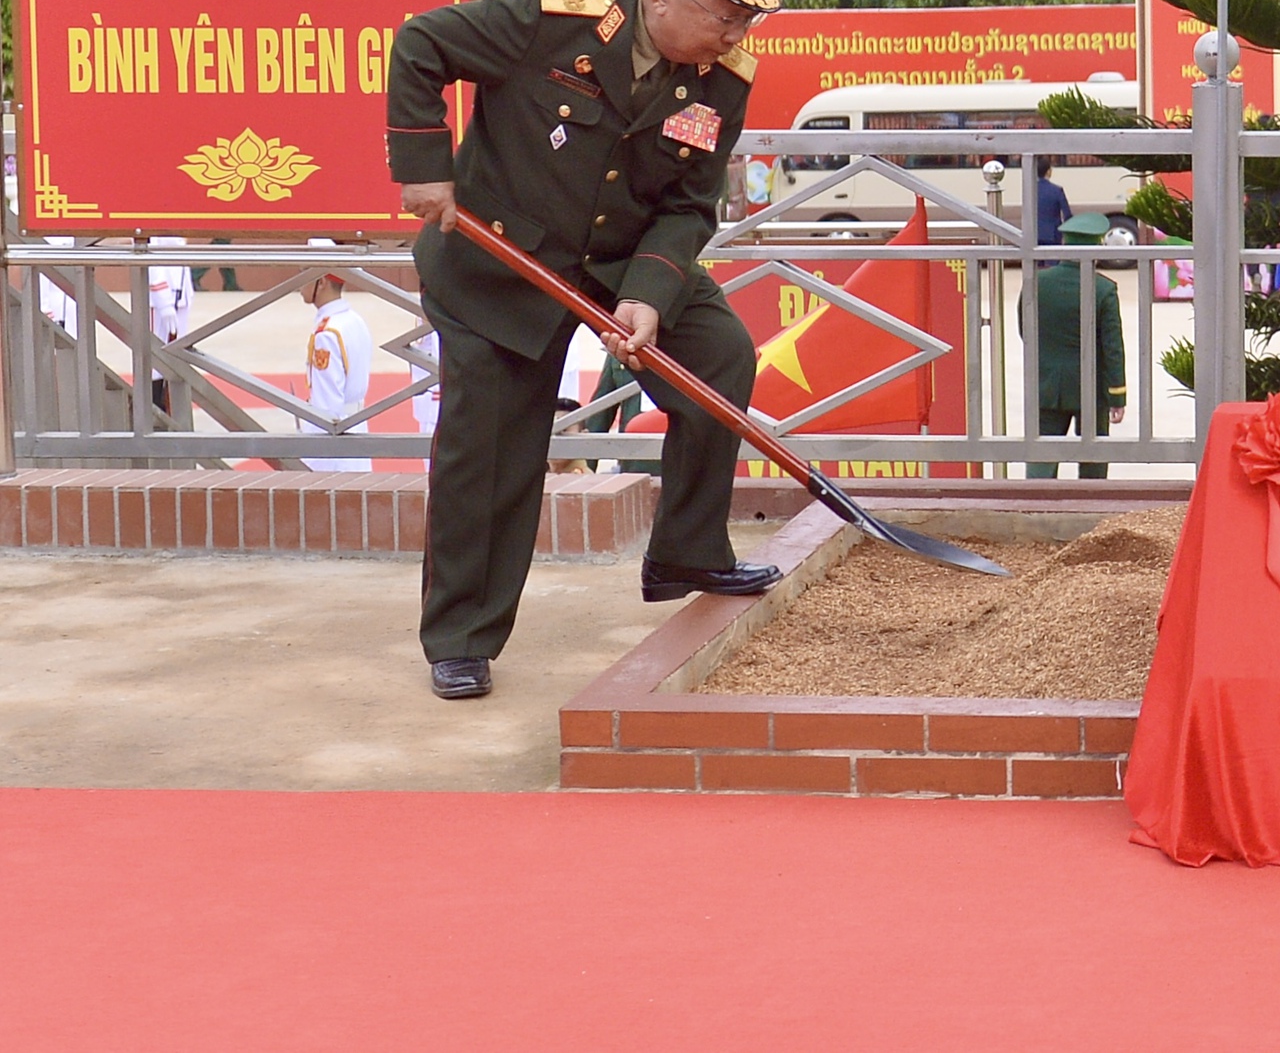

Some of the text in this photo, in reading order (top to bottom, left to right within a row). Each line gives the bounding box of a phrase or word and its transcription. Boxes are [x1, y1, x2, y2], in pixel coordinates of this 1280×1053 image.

[68, 13, 159, 93] BÌNH
[170, 14, 244, 93] YÊN
[257, 14, 345, 93] BIÊN
